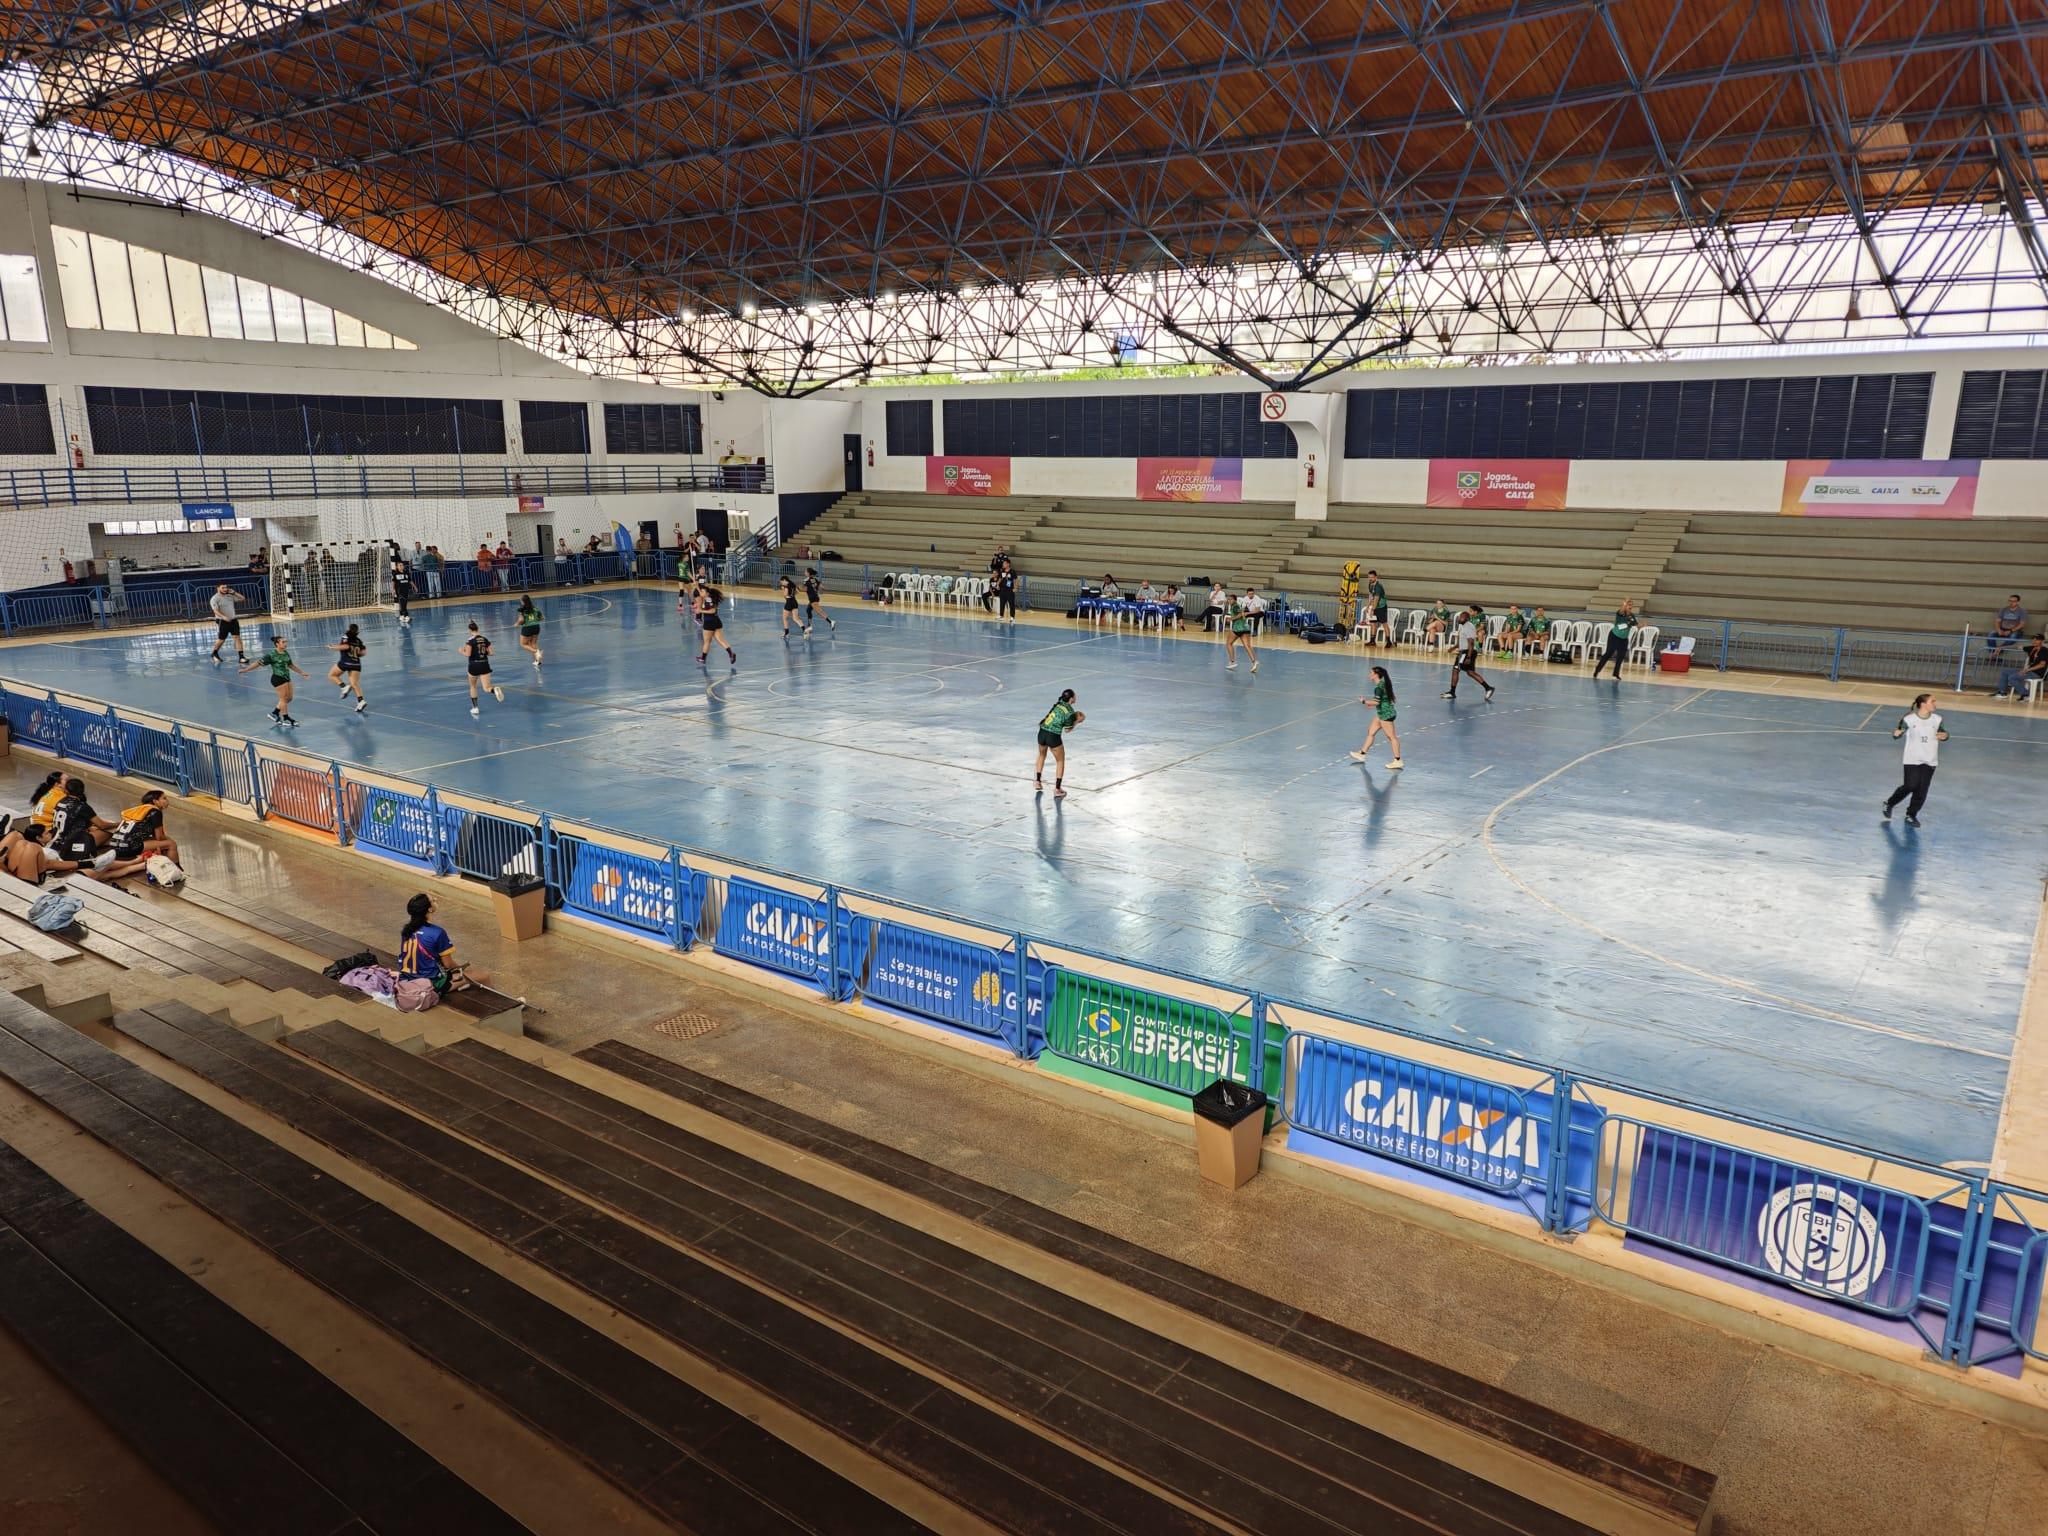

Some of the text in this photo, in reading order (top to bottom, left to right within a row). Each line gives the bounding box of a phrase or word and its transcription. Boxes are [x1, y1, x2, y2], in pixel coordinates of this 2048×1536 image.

[1484, 472, 1511, 483] Jogos
[1487, 481, 1535, 490] Juventude
[1156, 483, 1222, 492] NAÇÃO ESPORTIVA
[1505, 491, 1535, 499] CAIXA
[1172, 1024, 1223, 1046] OLÍMPCO
[1129, 1026, 1247, 1082] BRASIL
[1344, 1079, 1540, 1169] CAIXA
[1339, 1122, 1347, 1136] É
[1410, 1140, 1418, 1154] É
